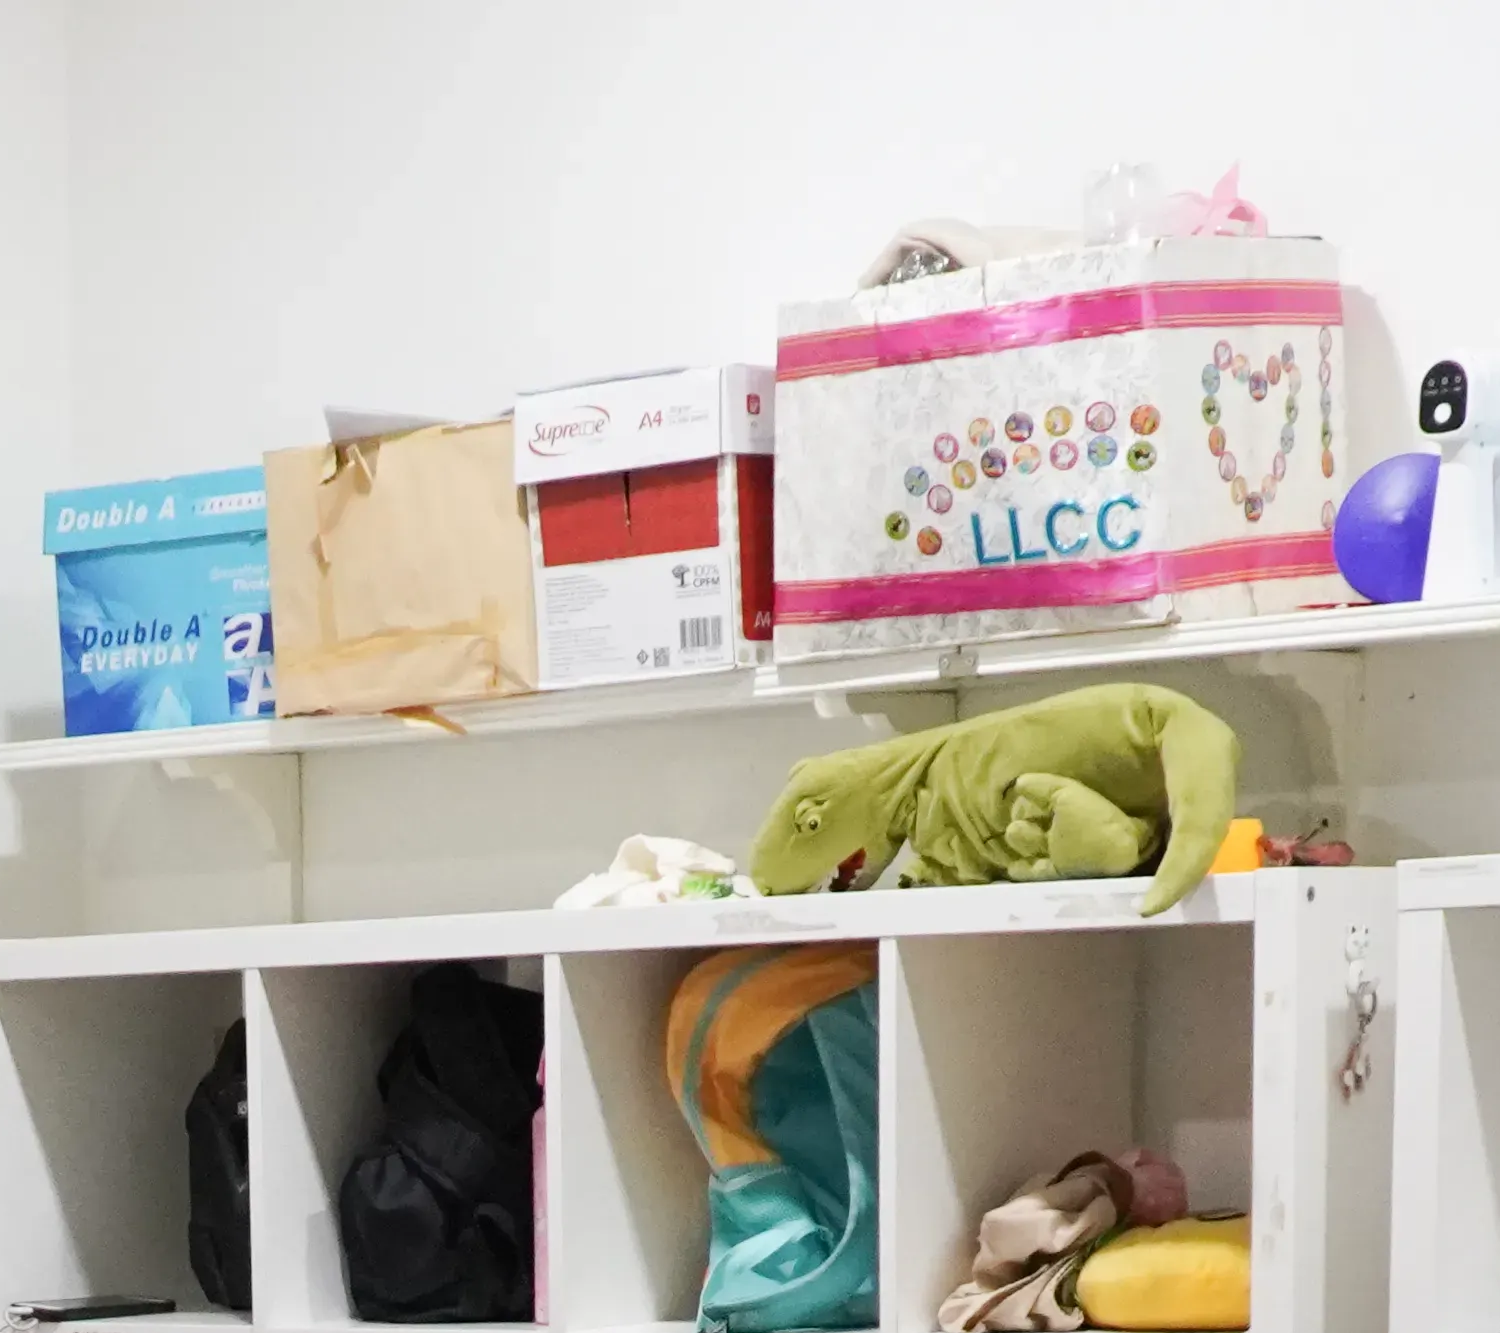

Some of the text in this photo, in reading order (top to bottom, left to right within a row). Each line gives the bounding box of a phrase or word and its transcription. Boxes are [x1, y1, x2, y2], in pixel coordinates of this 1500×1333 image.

[639, 411, 664, 431] A4
[56, 496, 175, 533] Double A
[971, 493, 1142, 565] LLCC
[81, 614, 201, 649] Double A
[80, 642, 199, 675] EVERYDAY
